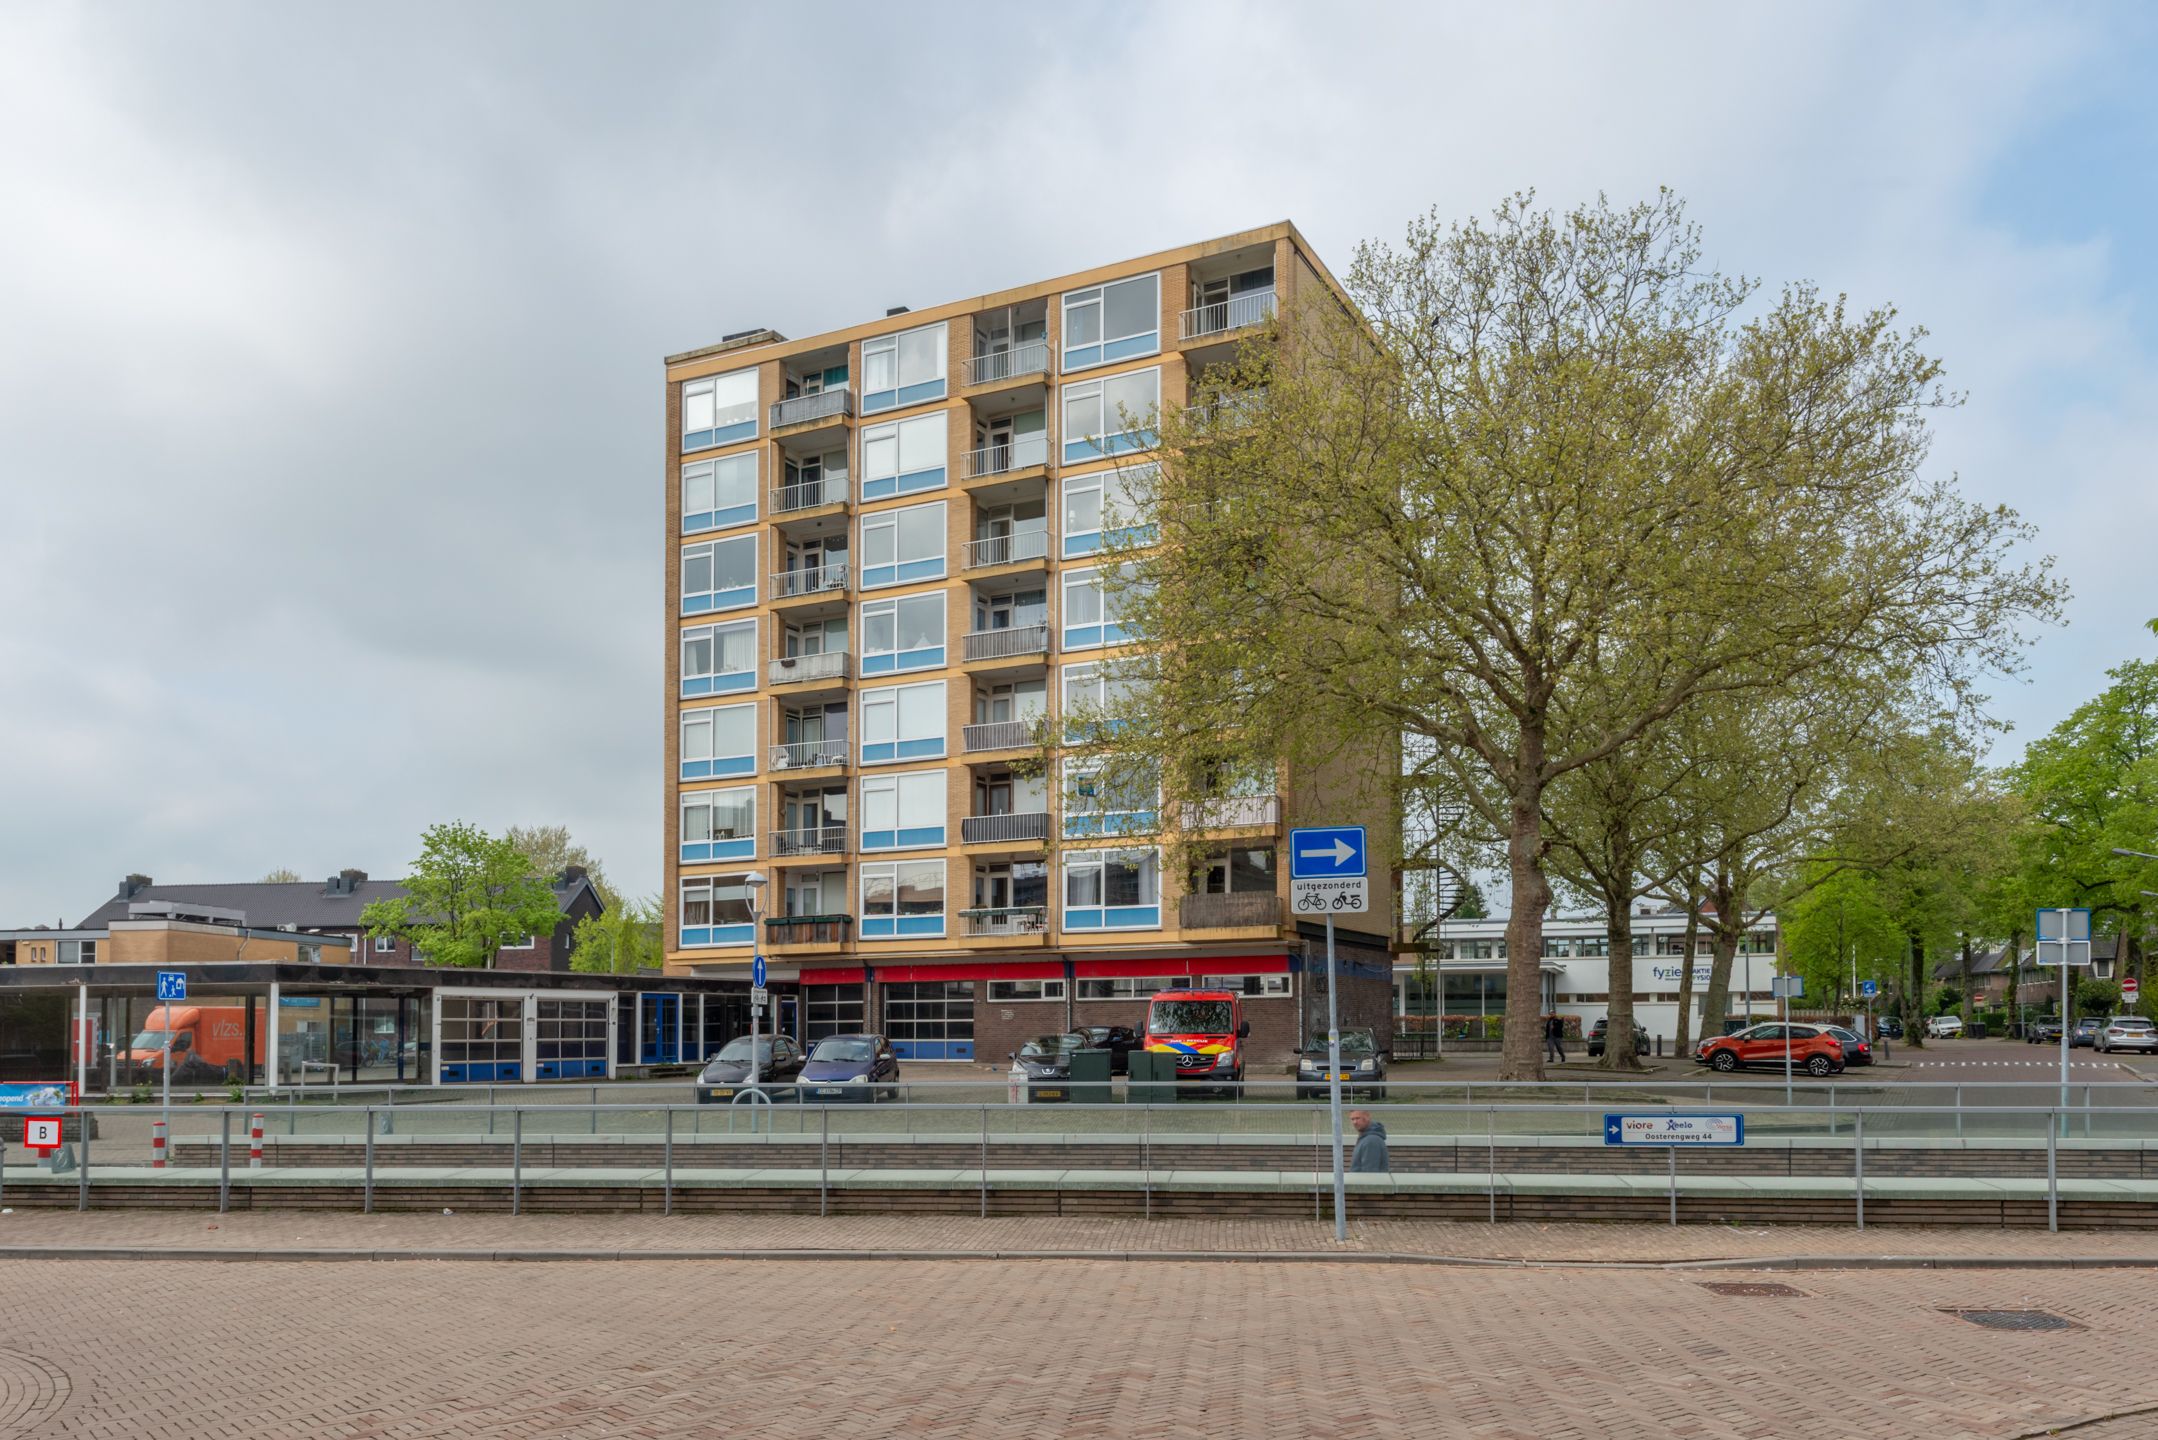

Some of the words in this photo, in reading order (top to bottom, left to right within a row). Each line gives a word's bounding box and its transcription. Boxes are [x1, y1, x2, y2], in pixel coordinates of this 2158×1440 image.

[1297, 881, 1361, 891] uitgezonderd
[1626, 1120, 1653, 1130] viore
[39, 1126, 48, 1140] B
[1645, 1133, 1700, 1141] Oosterengweg
